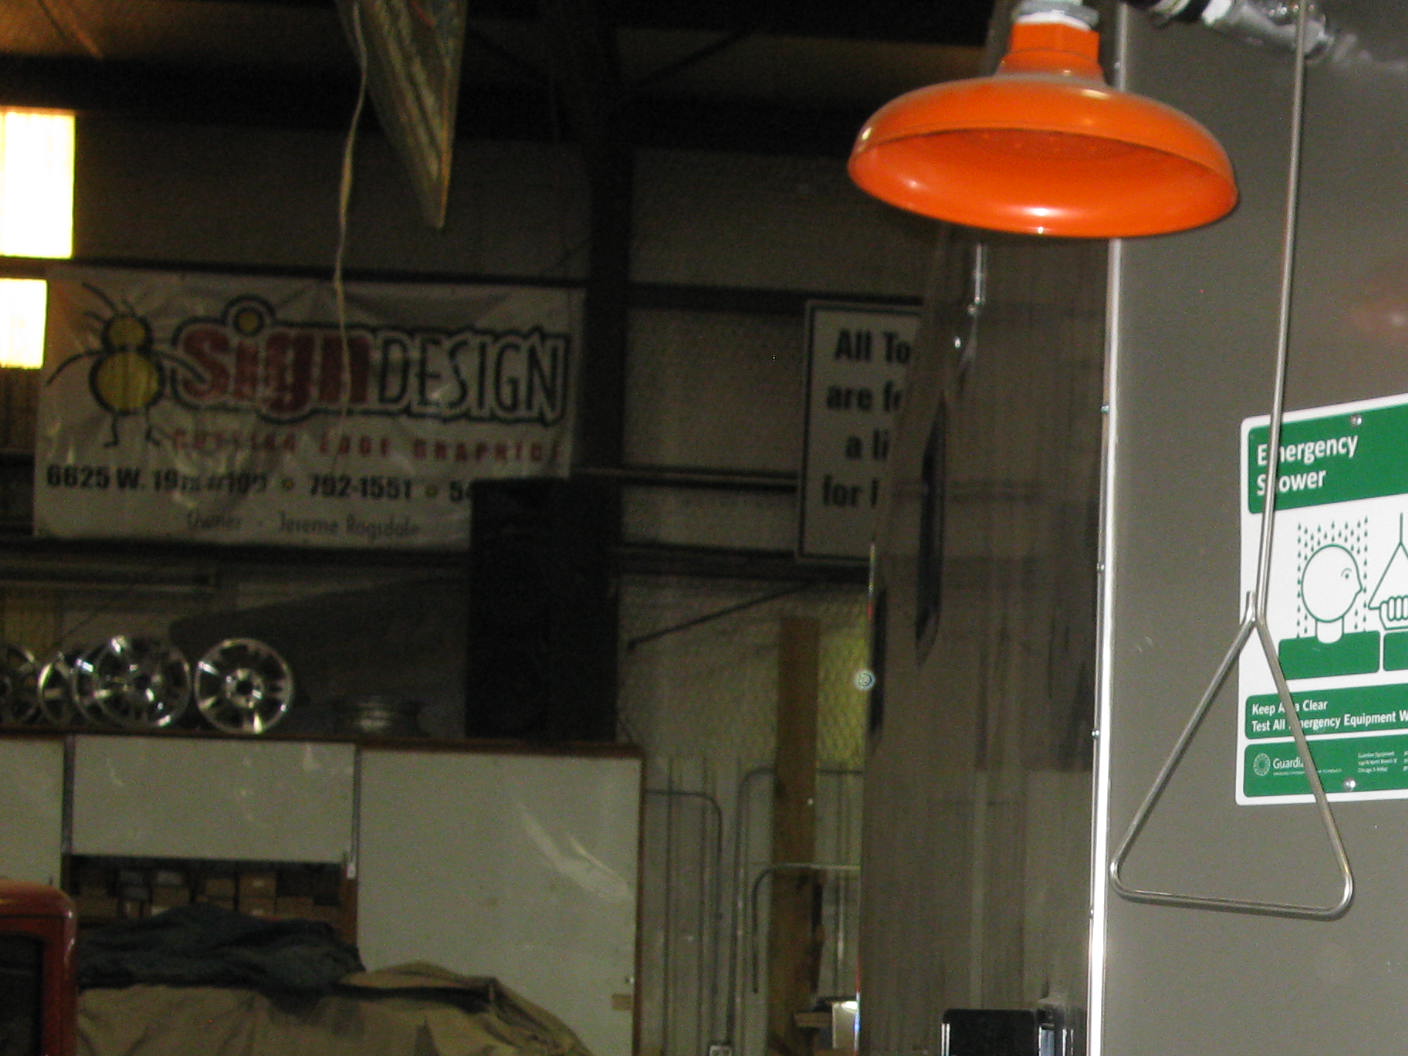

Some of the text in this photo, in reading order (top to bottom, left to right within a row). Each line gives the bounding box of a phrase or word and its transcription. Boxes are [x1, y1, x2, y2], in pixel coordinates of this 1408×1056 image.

[835, 328, 872, 363] All
[826, 384, 873, 412] are
[845, 435, 863, 460] a
[1257, 434, 1359, 466] Eergency
[46, 465, 111, 490] 6625
[1256, 468, 1327, 495] Sower
[822, 475, 863, 508] for
[1252, 699, 1329, 717] Keep Aa Clear
[1251, 719, 1271, 733] Test
[1272, 717, 1286, 731] All
[1343, 711, 1397, 727] Equipment
